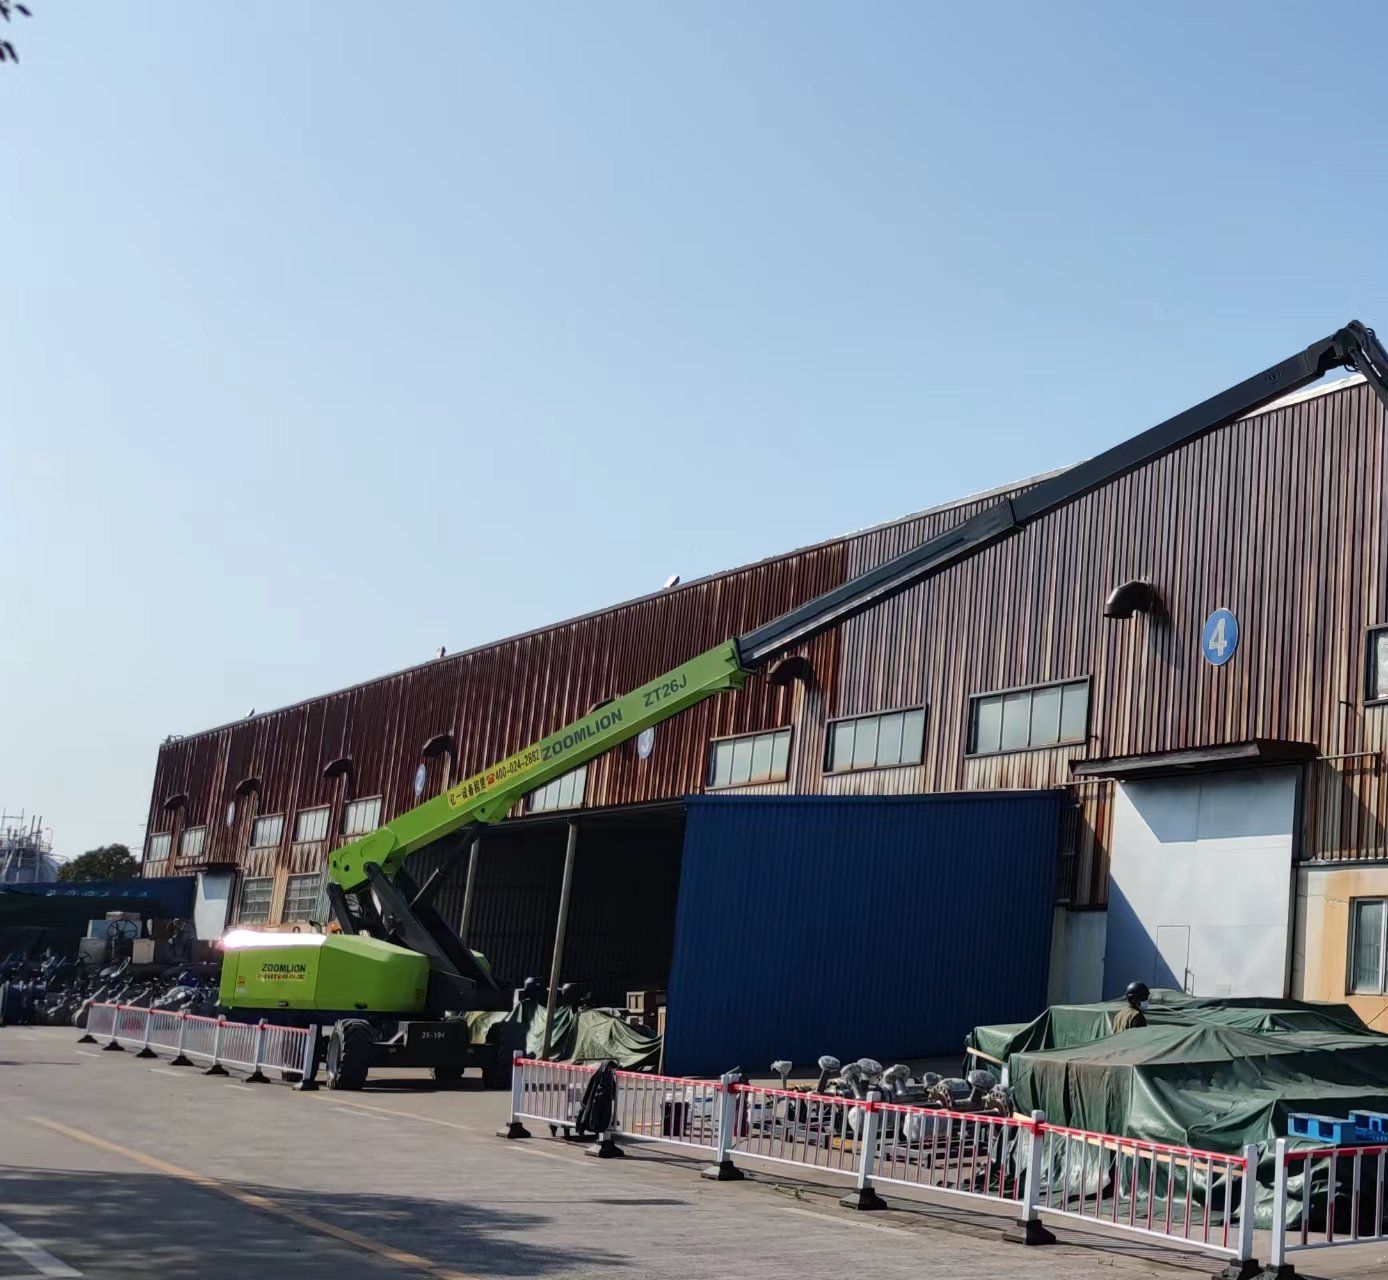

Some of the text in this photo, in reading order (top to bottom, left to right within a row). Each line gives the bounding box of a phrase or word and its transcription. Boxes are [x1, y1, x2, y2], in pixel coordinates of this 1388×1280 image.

[1208, 617, 1228, 657] 4
[644, 673, 687, 708] ZT26J
[543, 708, 623, 761] ZOOMLION
[261, 963, 307, 973] ZOOMLION
